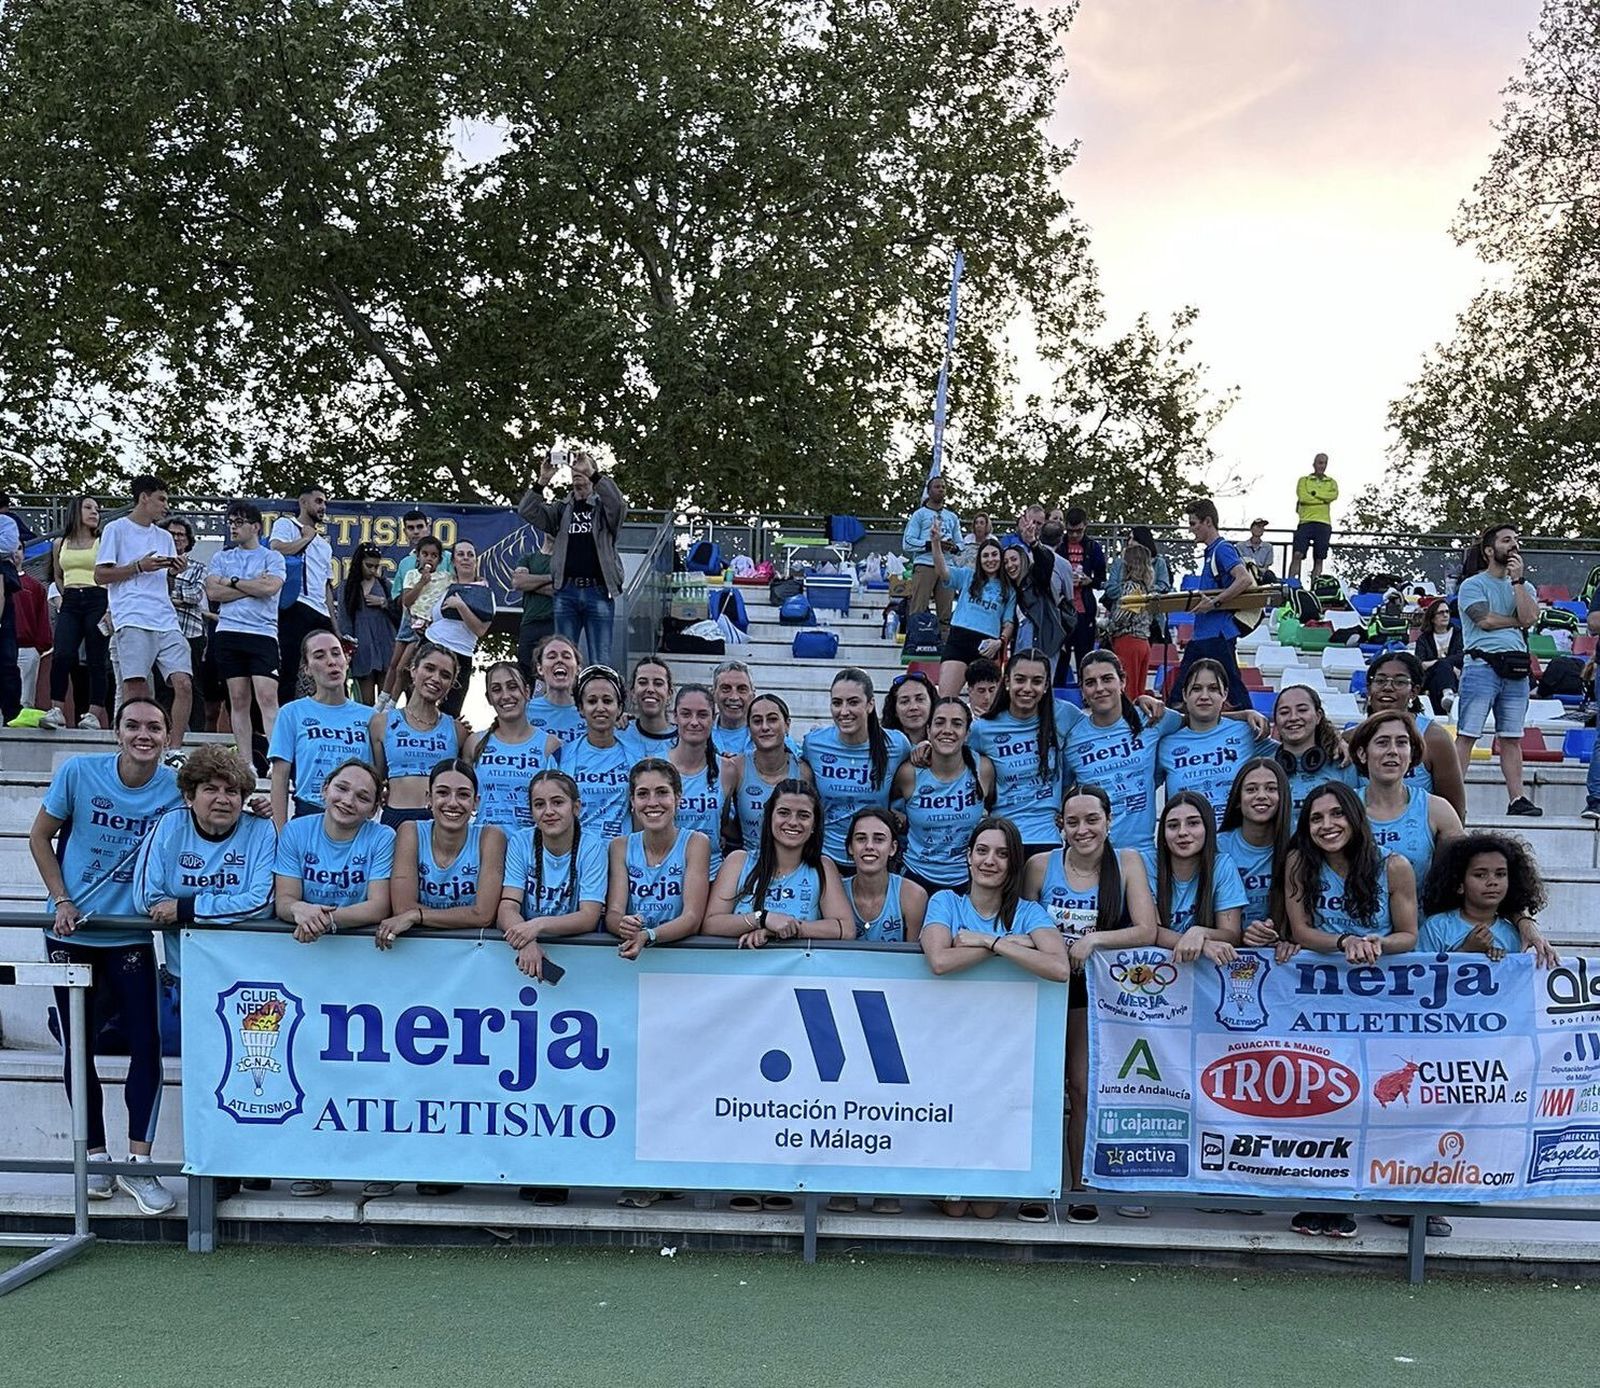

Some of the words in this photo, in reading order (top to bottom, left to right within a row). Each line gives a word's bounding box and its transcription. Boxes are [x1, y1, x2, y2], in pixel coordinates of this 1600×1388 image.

[307, 727, 367, 744] nerja
[319, 745, 361, 754] ATLETISMO
[397, 737, 447, 752] nerja
[1081, 737, 1145, 766] nerja
[404, 751, 442, 759] ATLETISMO
[481, 753, 540, 769] nerja
[487, 769, 533, 778] ATLETISMO
[1093, 757, 1141, 775] ATLETISMO
[1183, 766, 1232, 780] ATLETISMO
[575, 769, 629, 786] nerja
[919, 790, 977, 811] nerja
[927, 813, 971, 822] ATLETISMO
[182, 869, 240, 889] nerja
[304, 865, 366, 889] nerja
[309, 887, 358, 898] ATLETISMO
[1117, 951, 1167, 965] CMD
[1295, 952, 1499, 1010] nerja
[240, 990, 278, 1002] CLUB
[1116, 991, 1169, 1010] NERJA
[236, 1002, 282, 1016] NERJA
[1223, 1017, 1262, 1026] ATLETISMO
[1288, 1012, 1507, 1034] ATLETISMO
[320, 986, 610, 1092] nerja
[1227, 1040, 1281, 1052] AGUACATE
[1284, 1040, 1291, 1048] &
[1293, 1041, 1331, 1057] MANGO
[1208, 1055, 1352, 1105] TROPS
[1418, 1060, 1509, 1083] CUEVA
[1123, 1083, 1136, 1093] de
[1138, 1084, 1191, 1100] Andalucía
[228, 1099, 293, 1114] ATLETISMO
[714, 1096, 838, 1123] Diputación
[843, 1100, 954, 1124] Provincial
[313, 1097, 617, 1139] ATLETISMO
[1121, 1113, 1186, 1135] cajamar
[774, 1128, 804, 1148] de
[809, 1128, 892, 1155] Málaga
[1229, 1134, 1352, 1159] BFwork
[1127, 1147, 1176, 1162] activa
[1227, 1161, 1350, 1178] Comunicaciones
